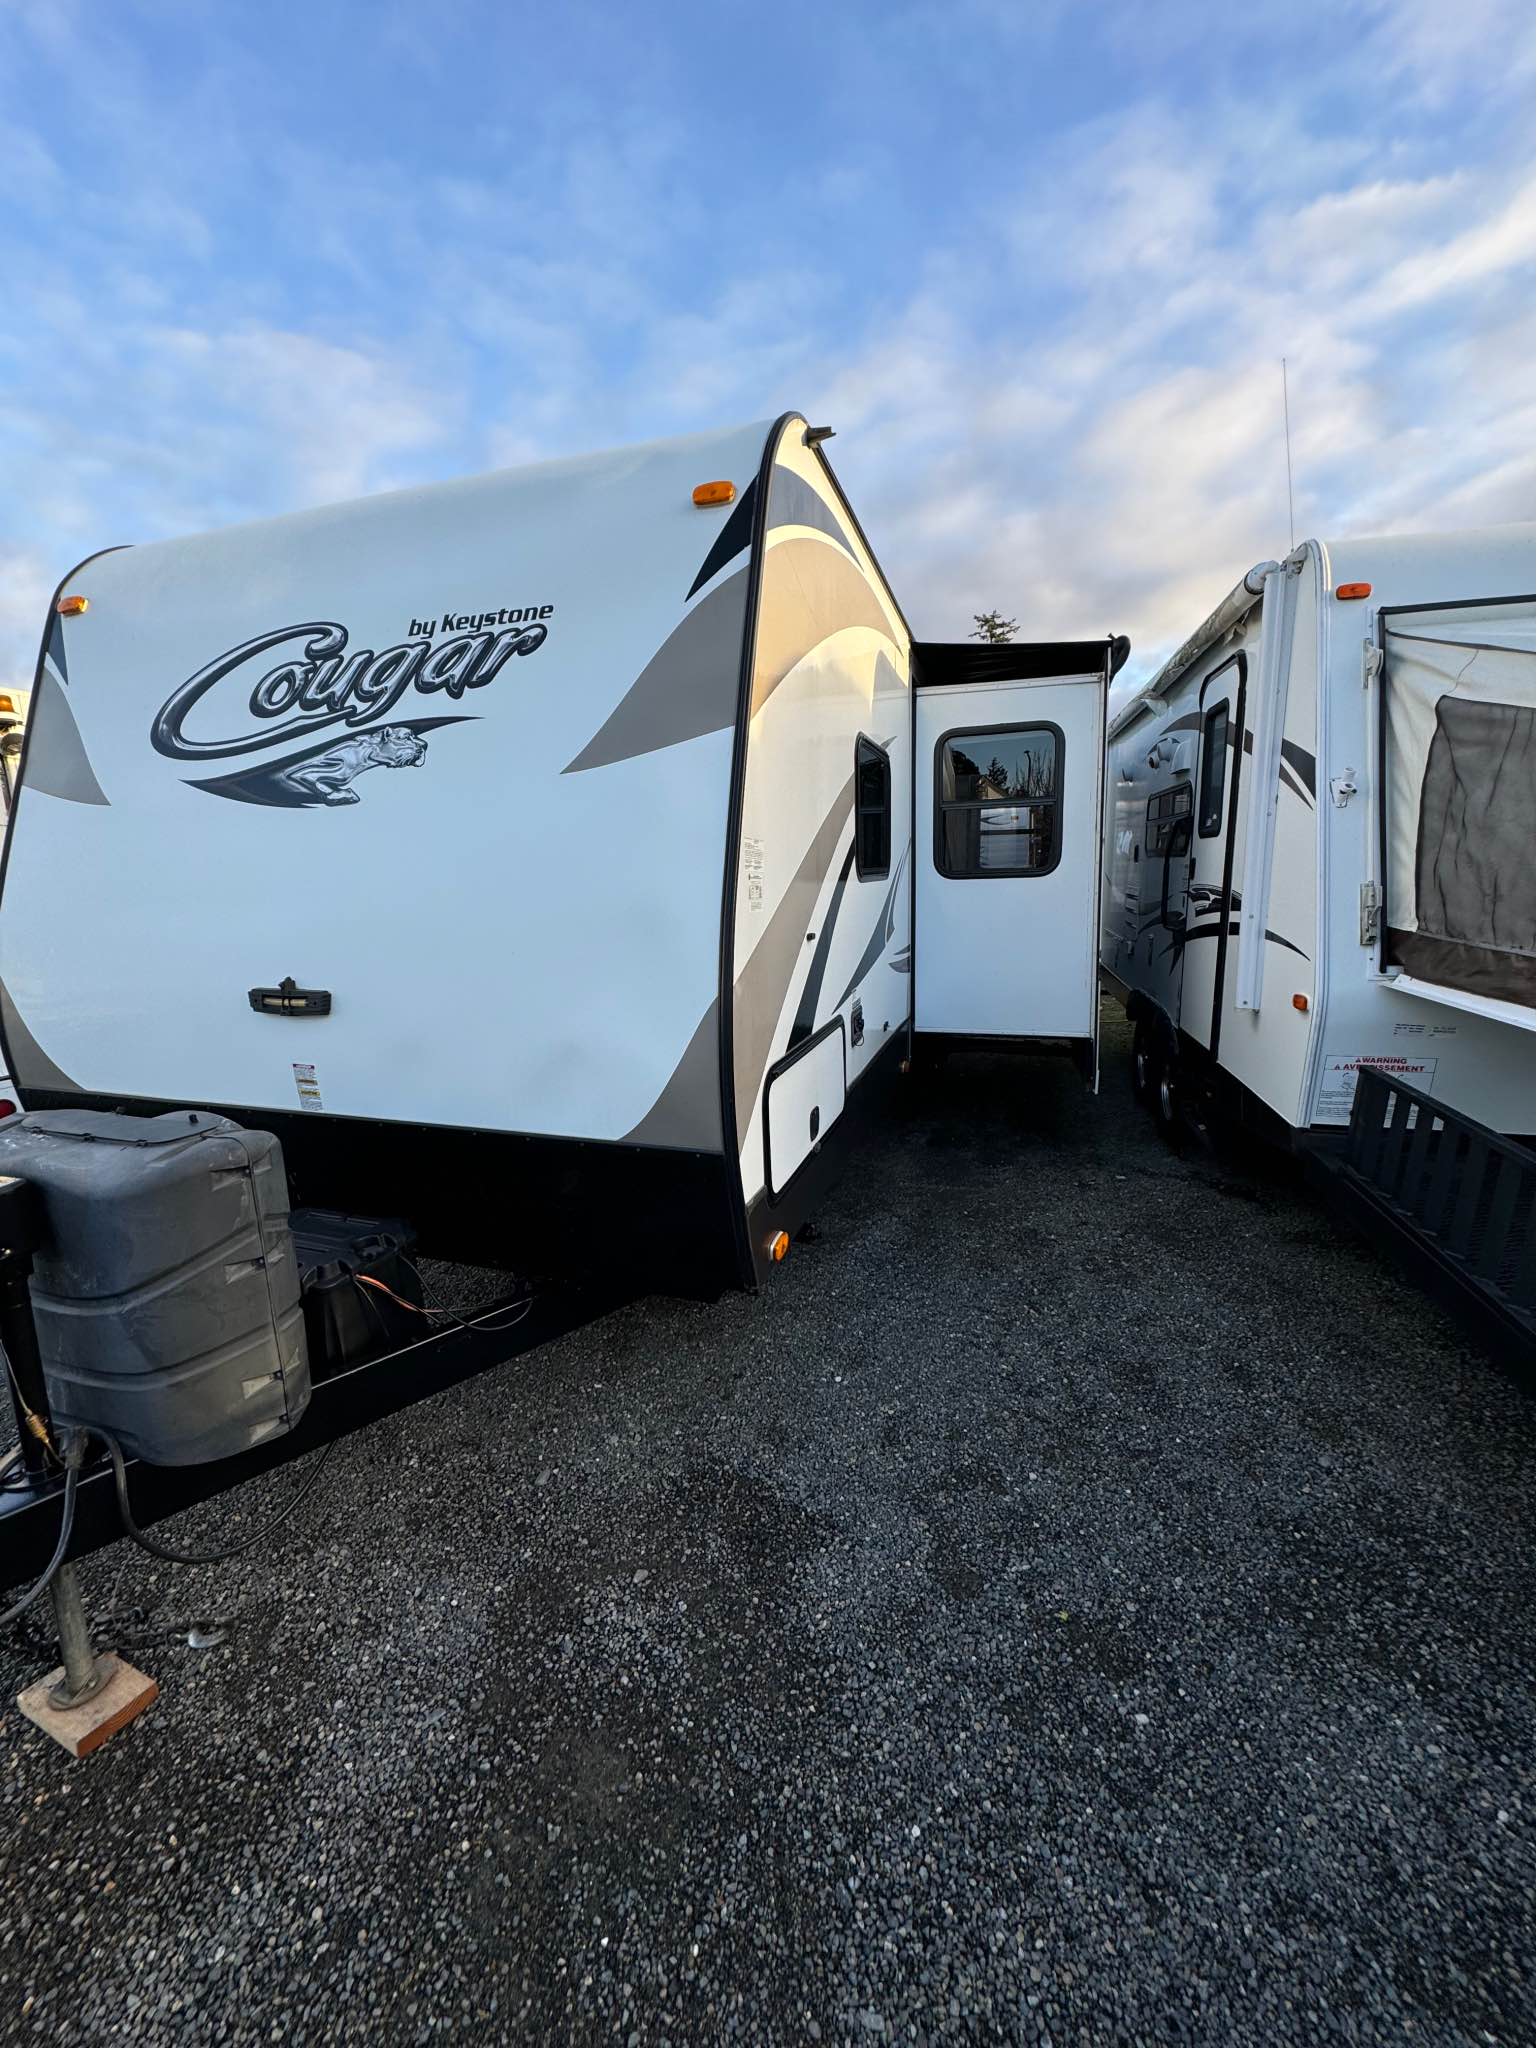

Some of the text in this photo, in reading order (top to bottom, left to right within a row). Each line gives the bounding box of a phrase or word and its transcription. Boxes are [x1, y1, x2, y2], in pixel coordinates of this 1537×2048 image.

[408, 605, 554, 640] by Keystone
[150, 621, 548, 761] Cougar
[1343, 1064, 1425, 1072] AVEISSEMENT
